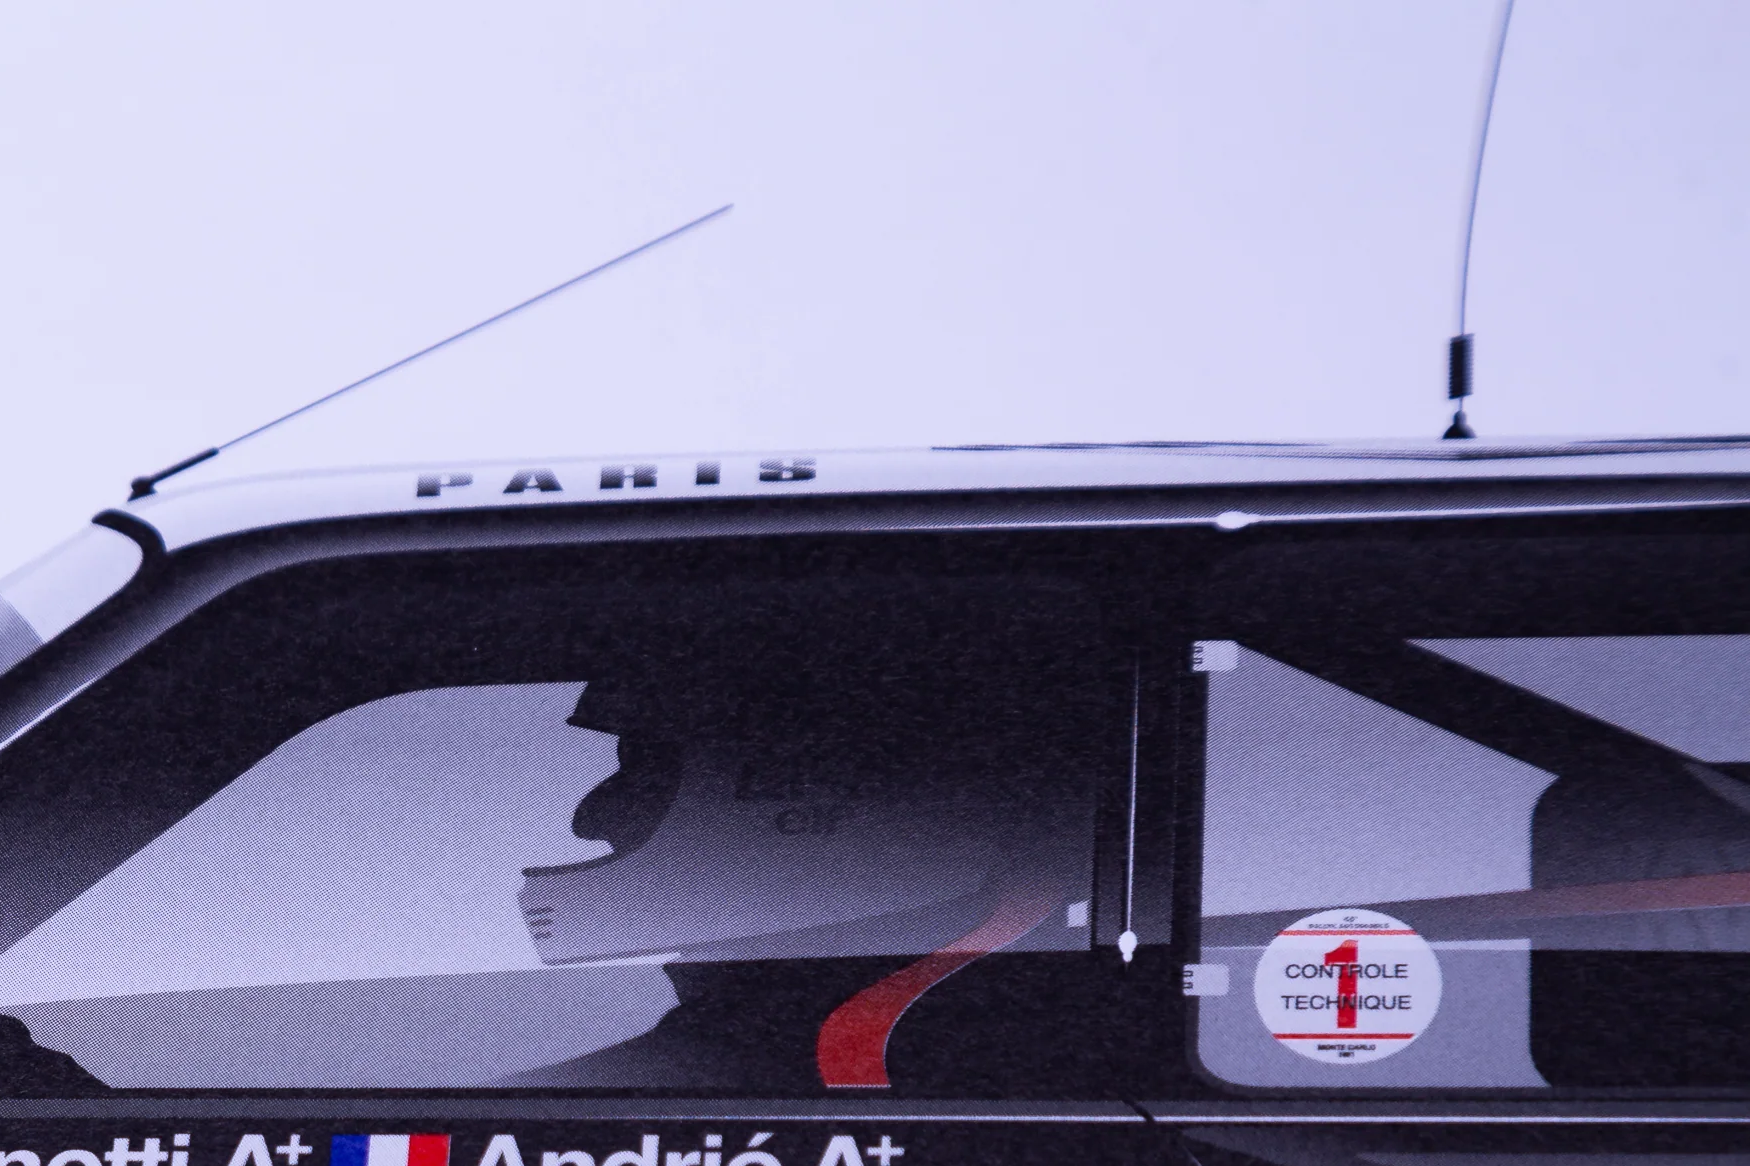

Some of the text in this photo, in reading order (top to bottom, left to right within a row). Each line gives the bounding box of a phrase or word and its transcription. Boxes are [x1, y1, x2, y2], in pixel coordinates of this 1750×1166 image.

[416, 457, 817, 498] PARIS
[1285, 963, 1408, 979] CONTROLE
[1324, 938, 1359, 1029] 1
[1281, 995, 1412, 1010] TECHNIQUE
